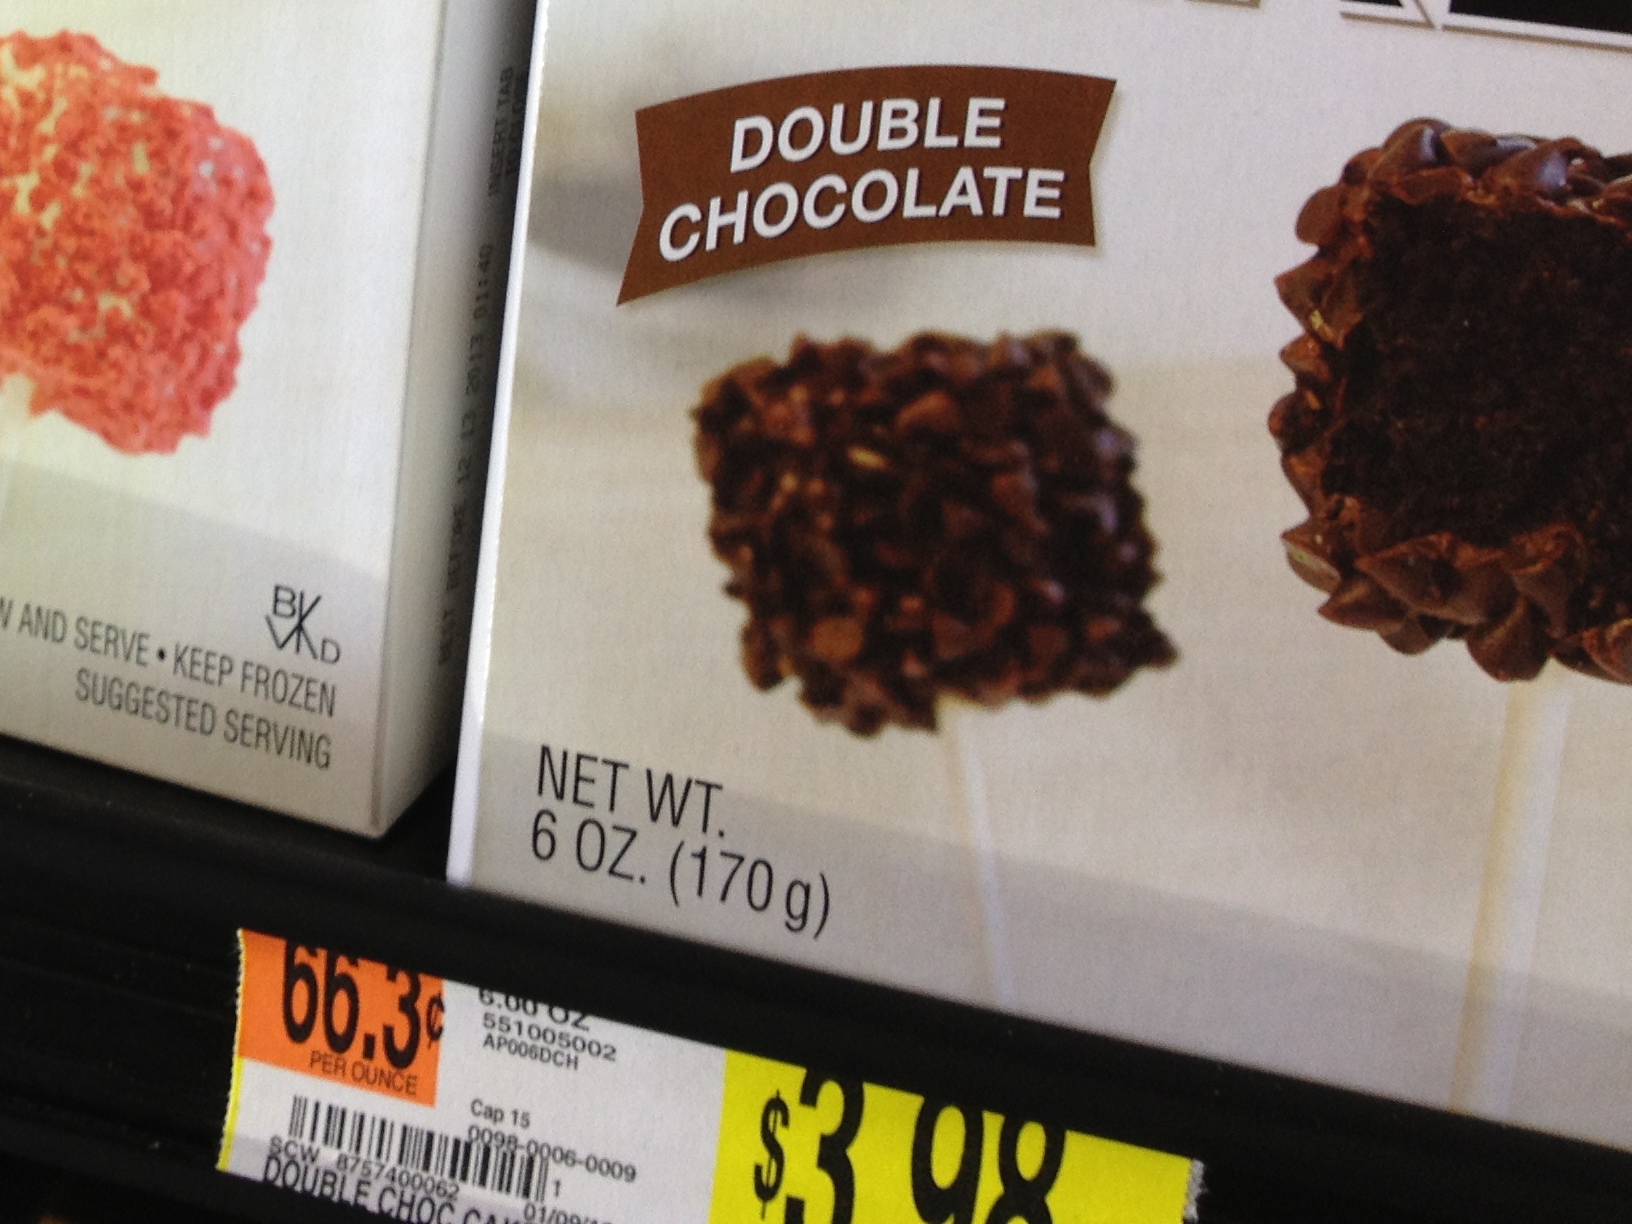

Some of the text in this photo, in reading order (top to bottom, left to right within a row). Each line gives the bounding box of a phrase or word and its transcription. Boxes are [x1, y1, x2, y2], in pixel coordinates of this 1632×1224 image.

[729, 96, 1007, 176] DOUBLE
[658, 166, 1066, 263] CHOCOLATE
[18, 602, 67, 643] AND
[74, 615, 150, 667] SERVE
[174, 640, 233, 687] KEEP
[240, 660, 336, 718] FROZEN
[75, 666, 332, 770] SUGGESTED SERVING
[537, 744, 726, 839] NET WT.
[532, 809, 558, 862] 6
[575, 818, 647, 885] OZ.
[482, 1012, 617, 1062] 551005002
[482, 1032, 579, 1071] AP006DCH
[310, 1049, 418, 1098] PER OUNCE
[470, 1098, 531, 1129] Cap 15
[753, 1068, 1066, 1224] $398
[265, 1154, 371, 1208] DOUBLE
[269, 1135, 320, 1164] SCW
[468, 1124, 638, 1183] 0098-0006-0009
